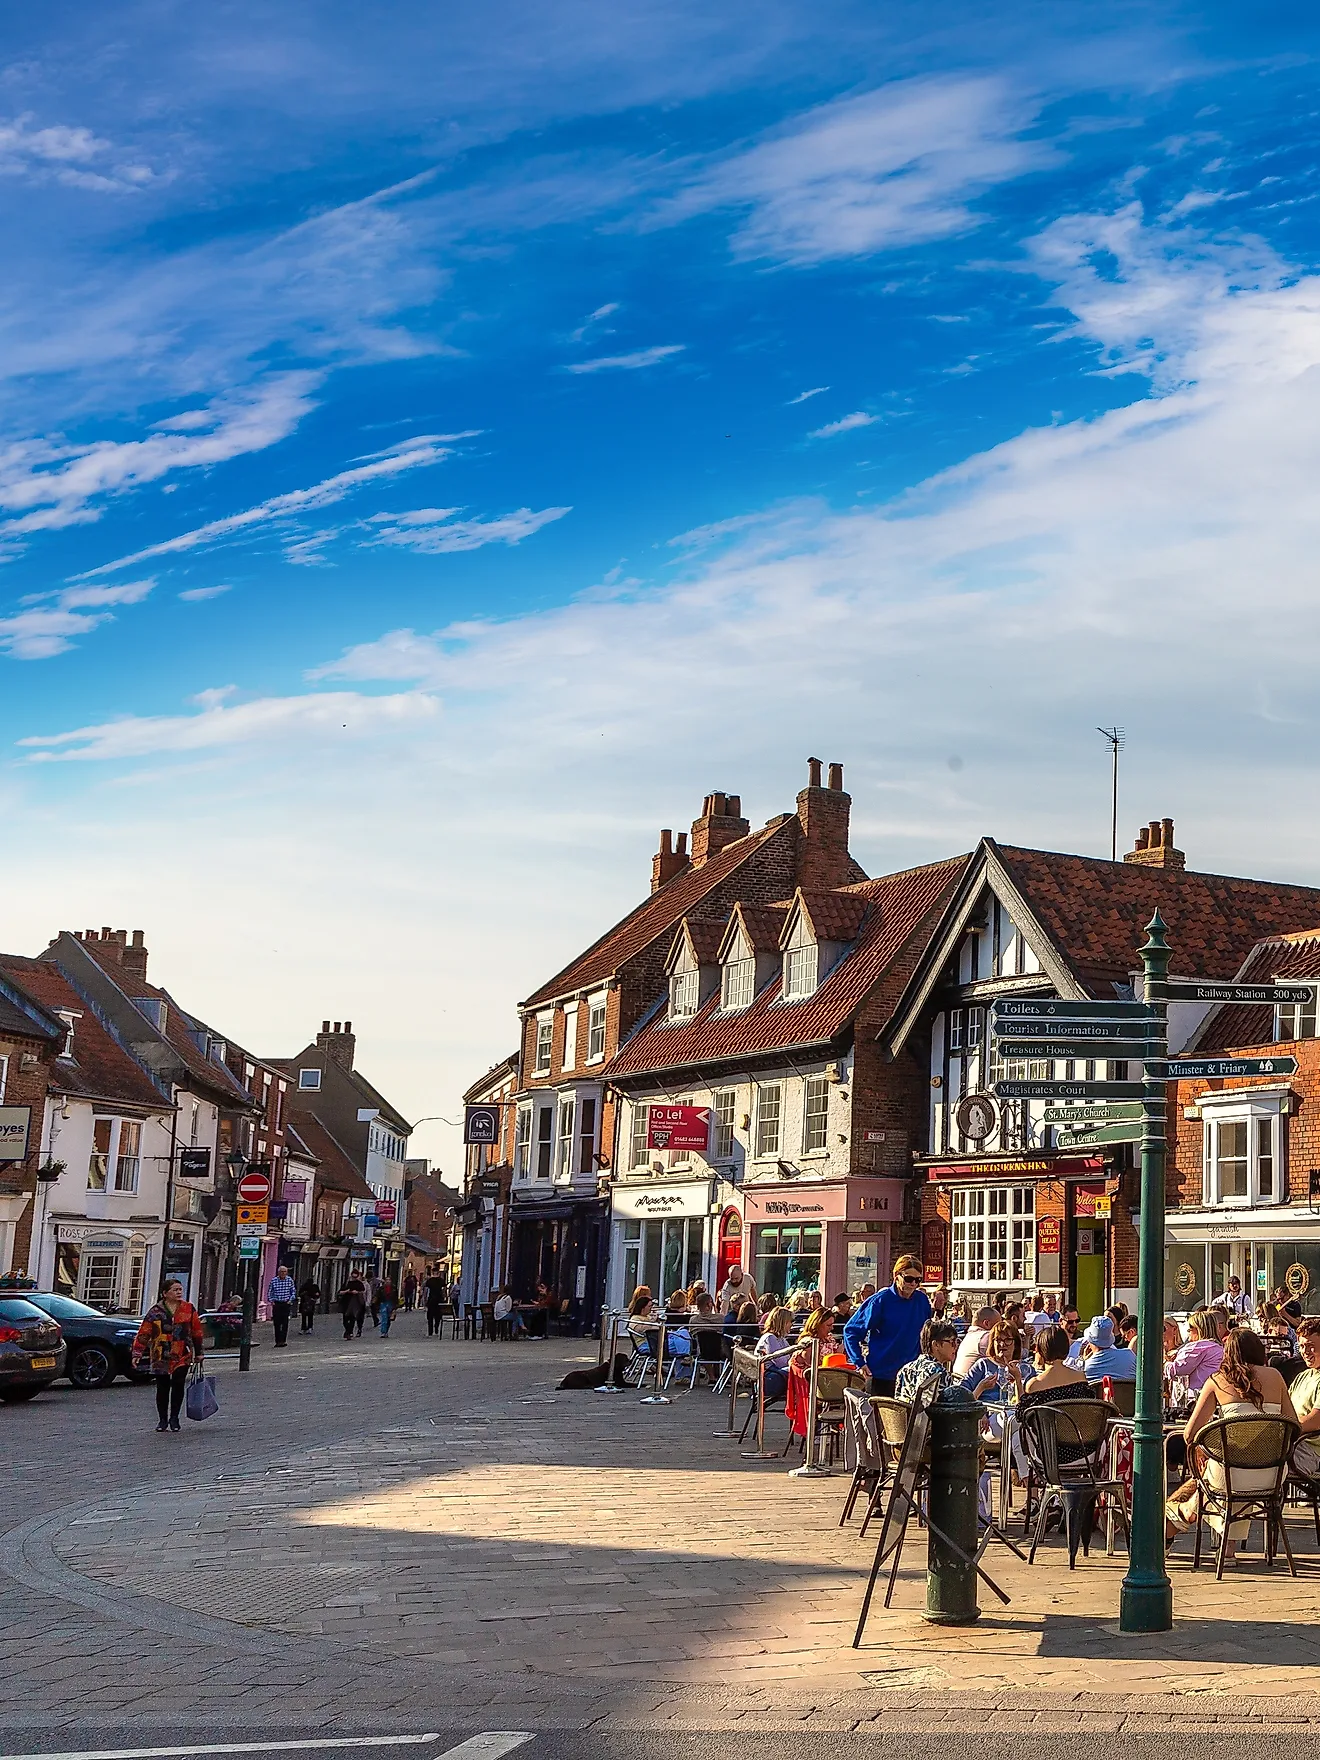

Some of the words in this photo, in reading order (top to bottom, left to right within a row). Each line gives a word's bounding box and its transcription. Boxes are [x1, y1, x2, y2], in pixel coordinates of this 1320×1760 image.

[1197, 988, 1233, 1000] Railway
[1235, 988, 1266, 999] Station
[1273, 989, 1289, 999] 500
[1292, 990, 1307, 1001] yds
[1002, 1003, 1040, 1014] Toilets
[1003, 1023, 1039, 1034] Tourist
[1045, 1023, 1109, 1036] Information
[1003, 1045, 1043, 1055] Treasure
[1046, 1045, 1076, 1055] House
[1168, 1064, 1204, 1075] Minster
[1207, 1064, 1216, 1074] &
[1220, 1063, 1248, 1074] Friary
[1000, 1084, 1054, 1096] Magistrates
[1058, 1085, 1087, 1095] Court
[652, 1109, 664, 1119] To
[667, 1109, 683, 1120] Let
[1048, 1109, 1058, 1119] St.
[1060, 1109, 1081, 1121] Mary's
[1083, 1107, 1110, 1118] Church
[654, 1132, 669, 1140] PPH
[1060, 1135, 1076, 1146] Town
[1077, 1133, 1098, 1144] Centre
[1043, 1221, 1055, 1229] THE
[1038, 1228, 1060, 1237] QUEENS
[926, 1265, 943, 1273] FOOD
